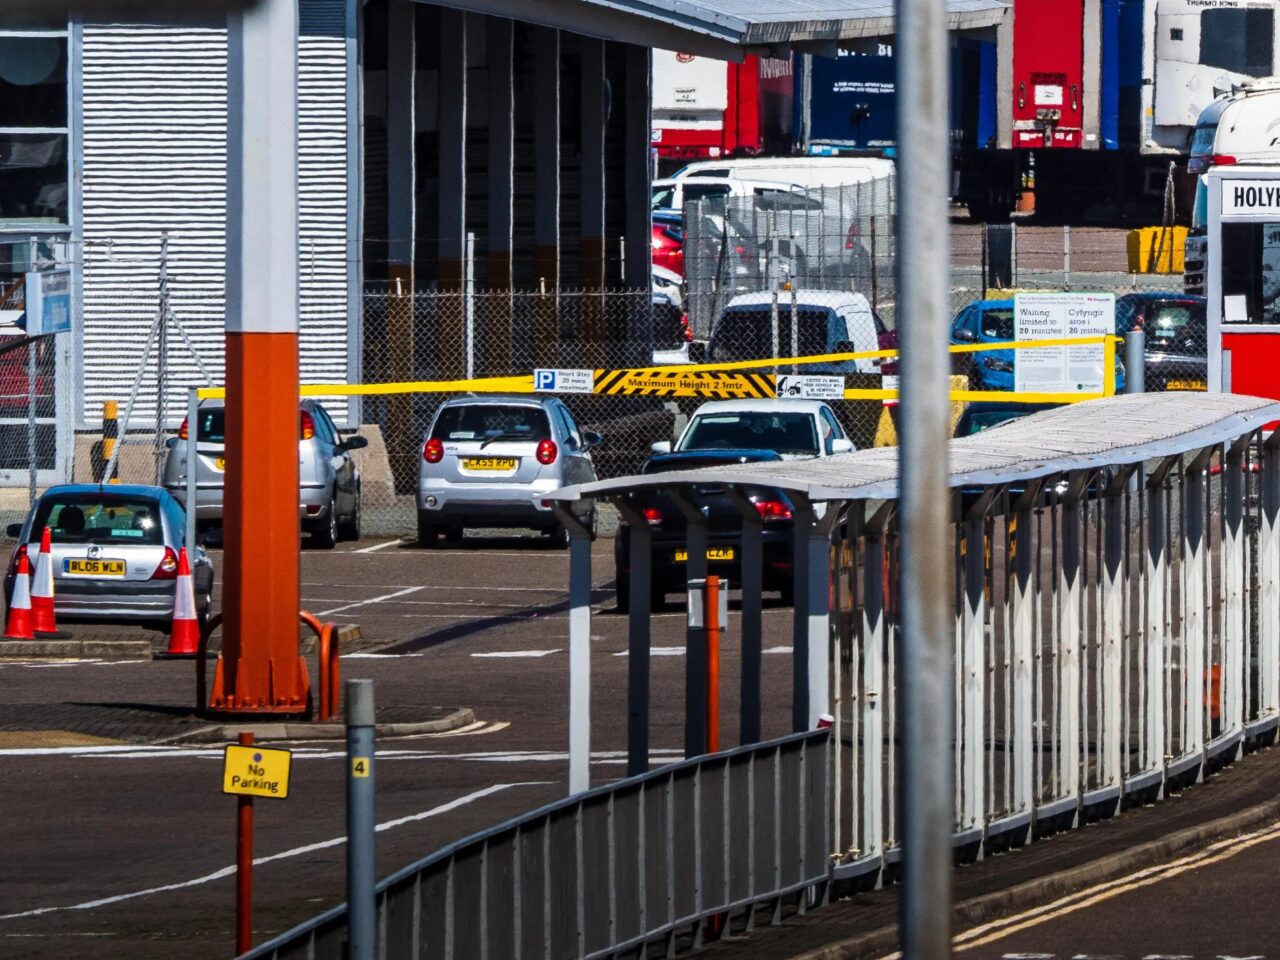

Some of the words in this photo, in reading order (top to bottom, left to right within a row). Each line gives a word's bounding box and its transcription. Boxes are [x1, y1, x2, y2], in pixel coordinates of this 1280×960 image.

[1186, 0, 1217, 7] THERMO
[1019, 308, 1050, 318] Waiting
[1019, 327, 1030, 335] 20
[1069, 327, 1078, 335] 20
[627, 378, 676, 388] Maximum
[680, 380, 710, 390] Height
[714, 381, 743, 389] 2.1mtr
[248, 763, 265, 777] No
[354, 761, 365, 774] 4
[231, 775, 279, 794] Parking
